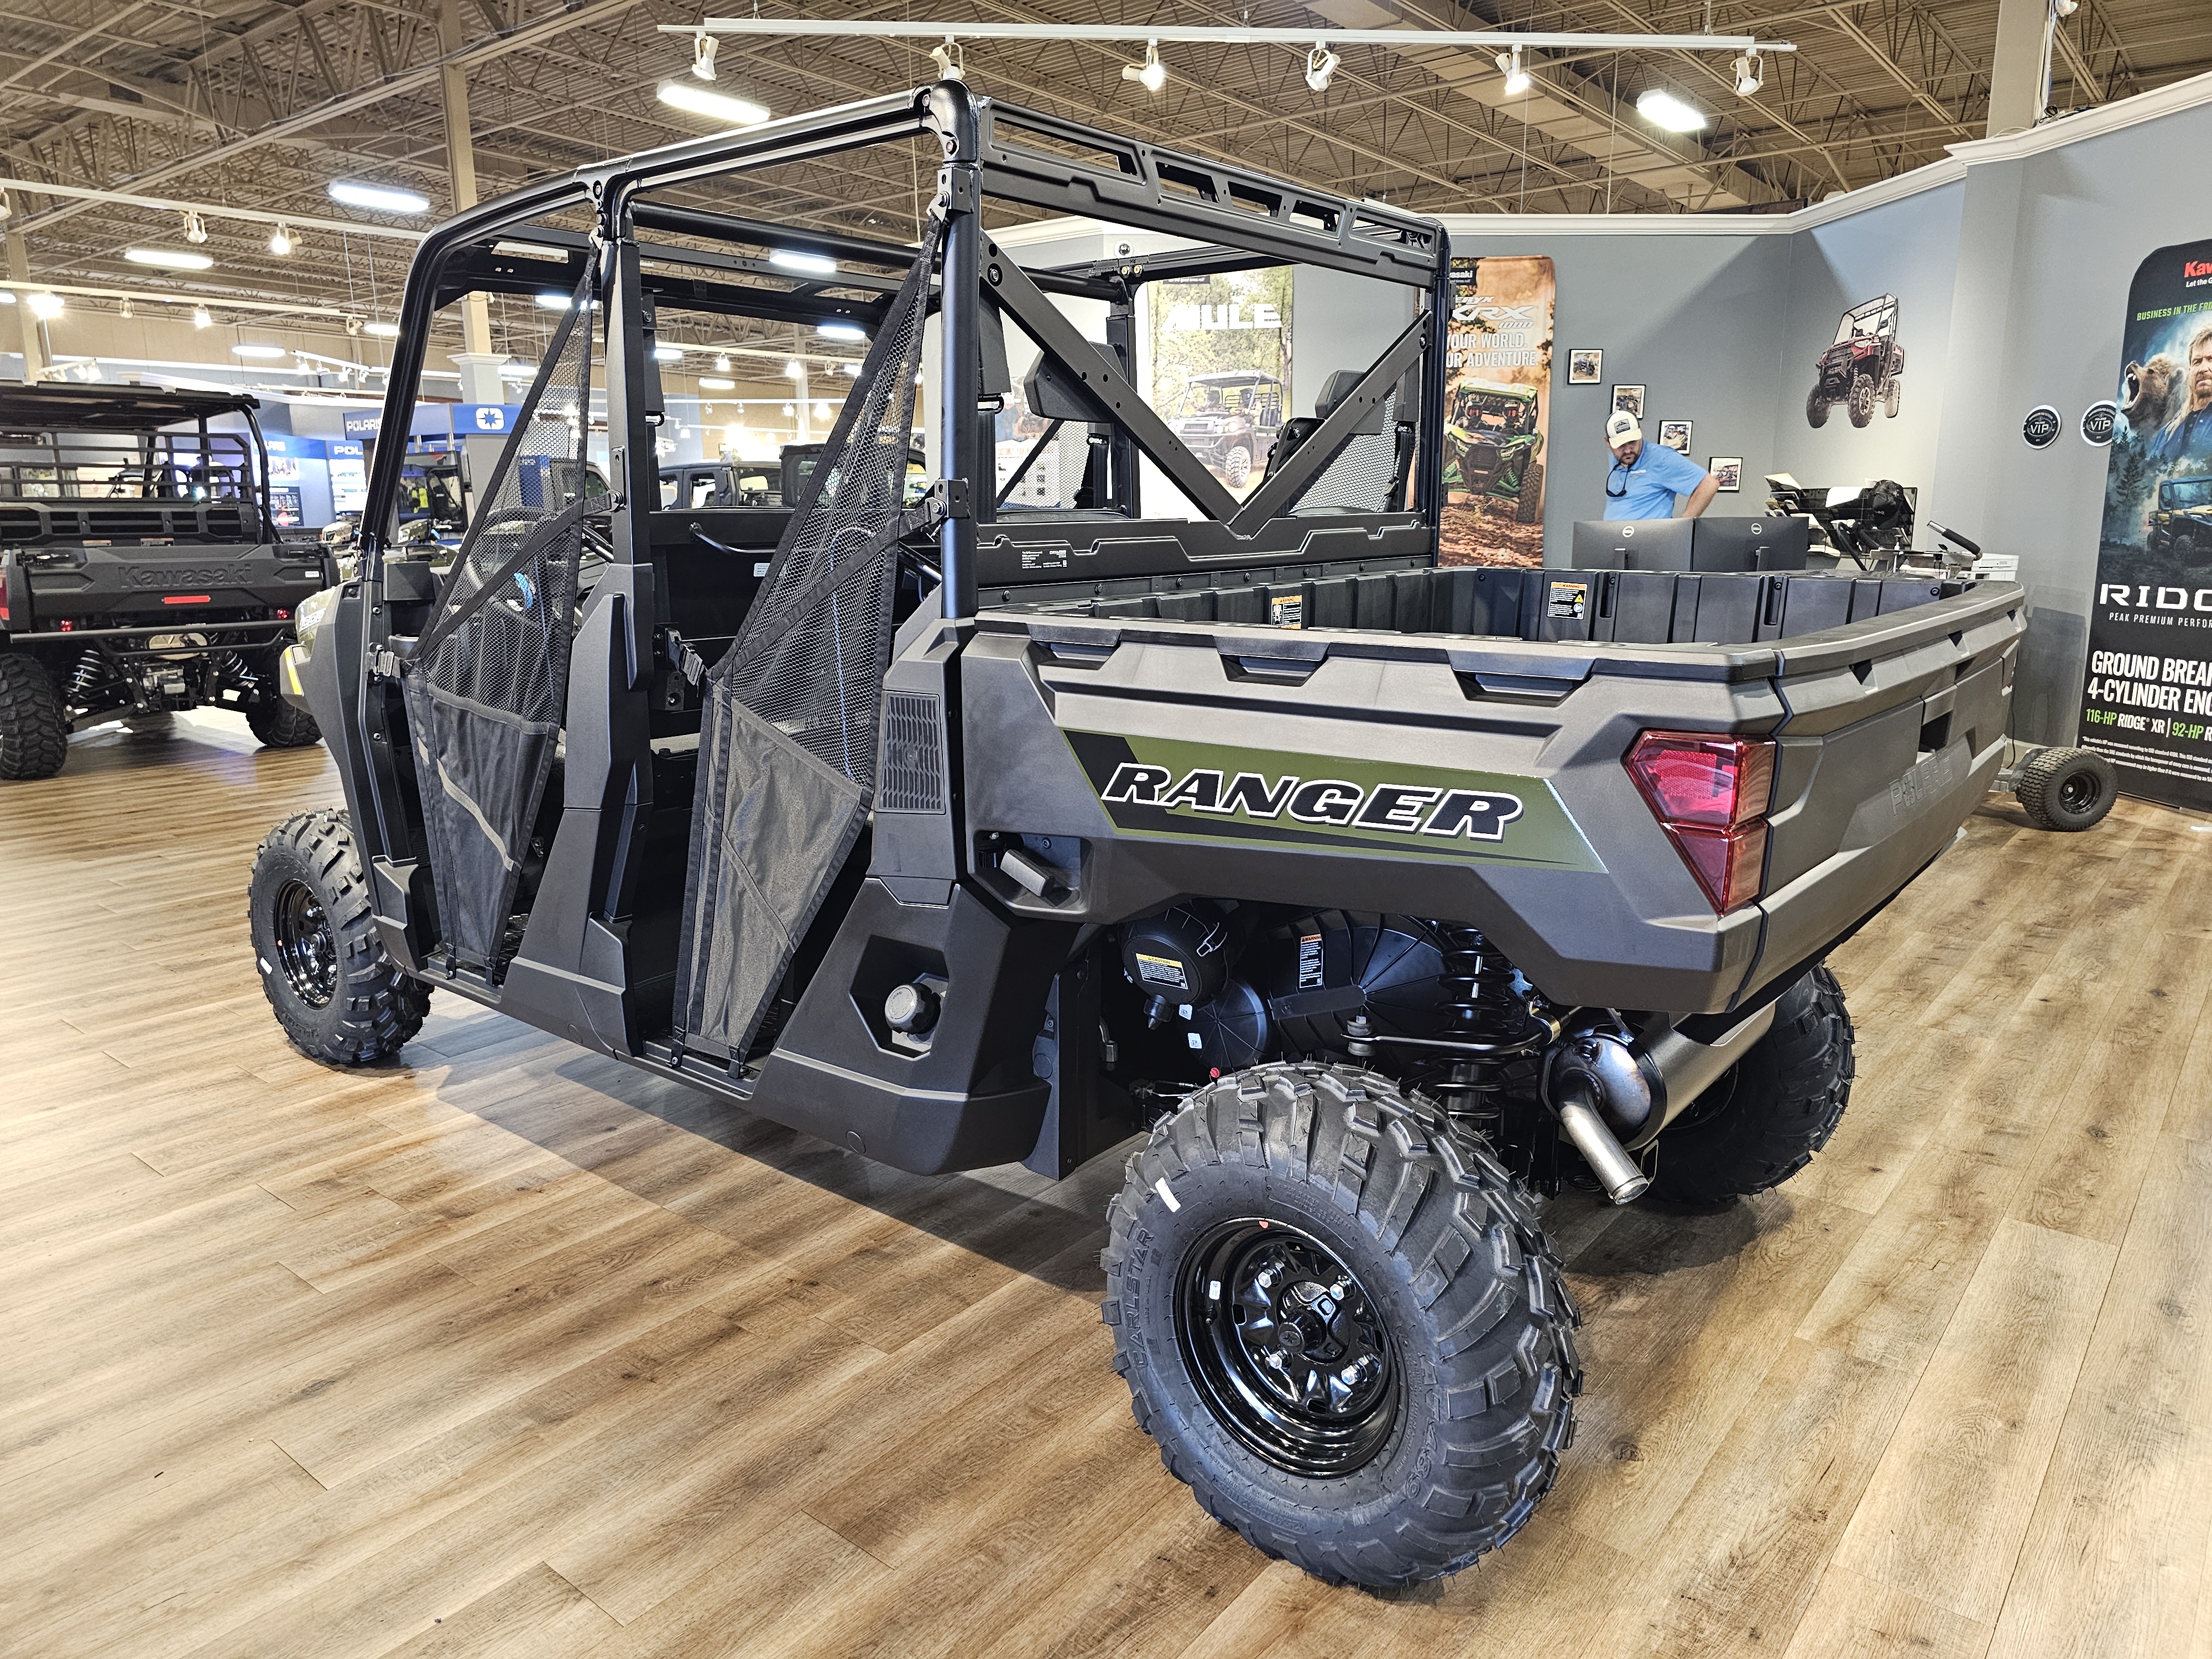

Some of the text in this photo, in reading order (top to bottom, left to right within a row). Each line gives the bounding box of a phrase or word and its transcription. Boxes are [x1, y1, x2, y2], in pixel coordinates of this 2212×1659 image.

[1161, 303, 1282, 331] MULE
[2136, 308, 2172, 321] BUSINESS
[2173, 306, 2181, 315] IN
[2183, 304, 2197, 314] THE
[1480, 333, 1527, 349] WORLD.
[1466, 351, 1539, 368] ADVENTURE.
[2031, 424, 2049, 434] VIP
[2090, 420, 2111, 431] VIP
[118, 563, 253, 588] Kawasaki
[2109, 613, 2129, 622] PEAK
[2133, 614, 2173, 625] PREMIUM
[2091, 650, 2159, 680] GROUND
[2088, 677, 2181, 712] 4-CYLINDER
[2086, 708, 2117, 726] 116-HP
[2151, 718, 2165, 734] XR
[2172, 722, 2204, 739] 92-HP
[1101, 762, 1524, 842] RANGER
[1126, 1227, 1154, 1368] CARLSTAR
